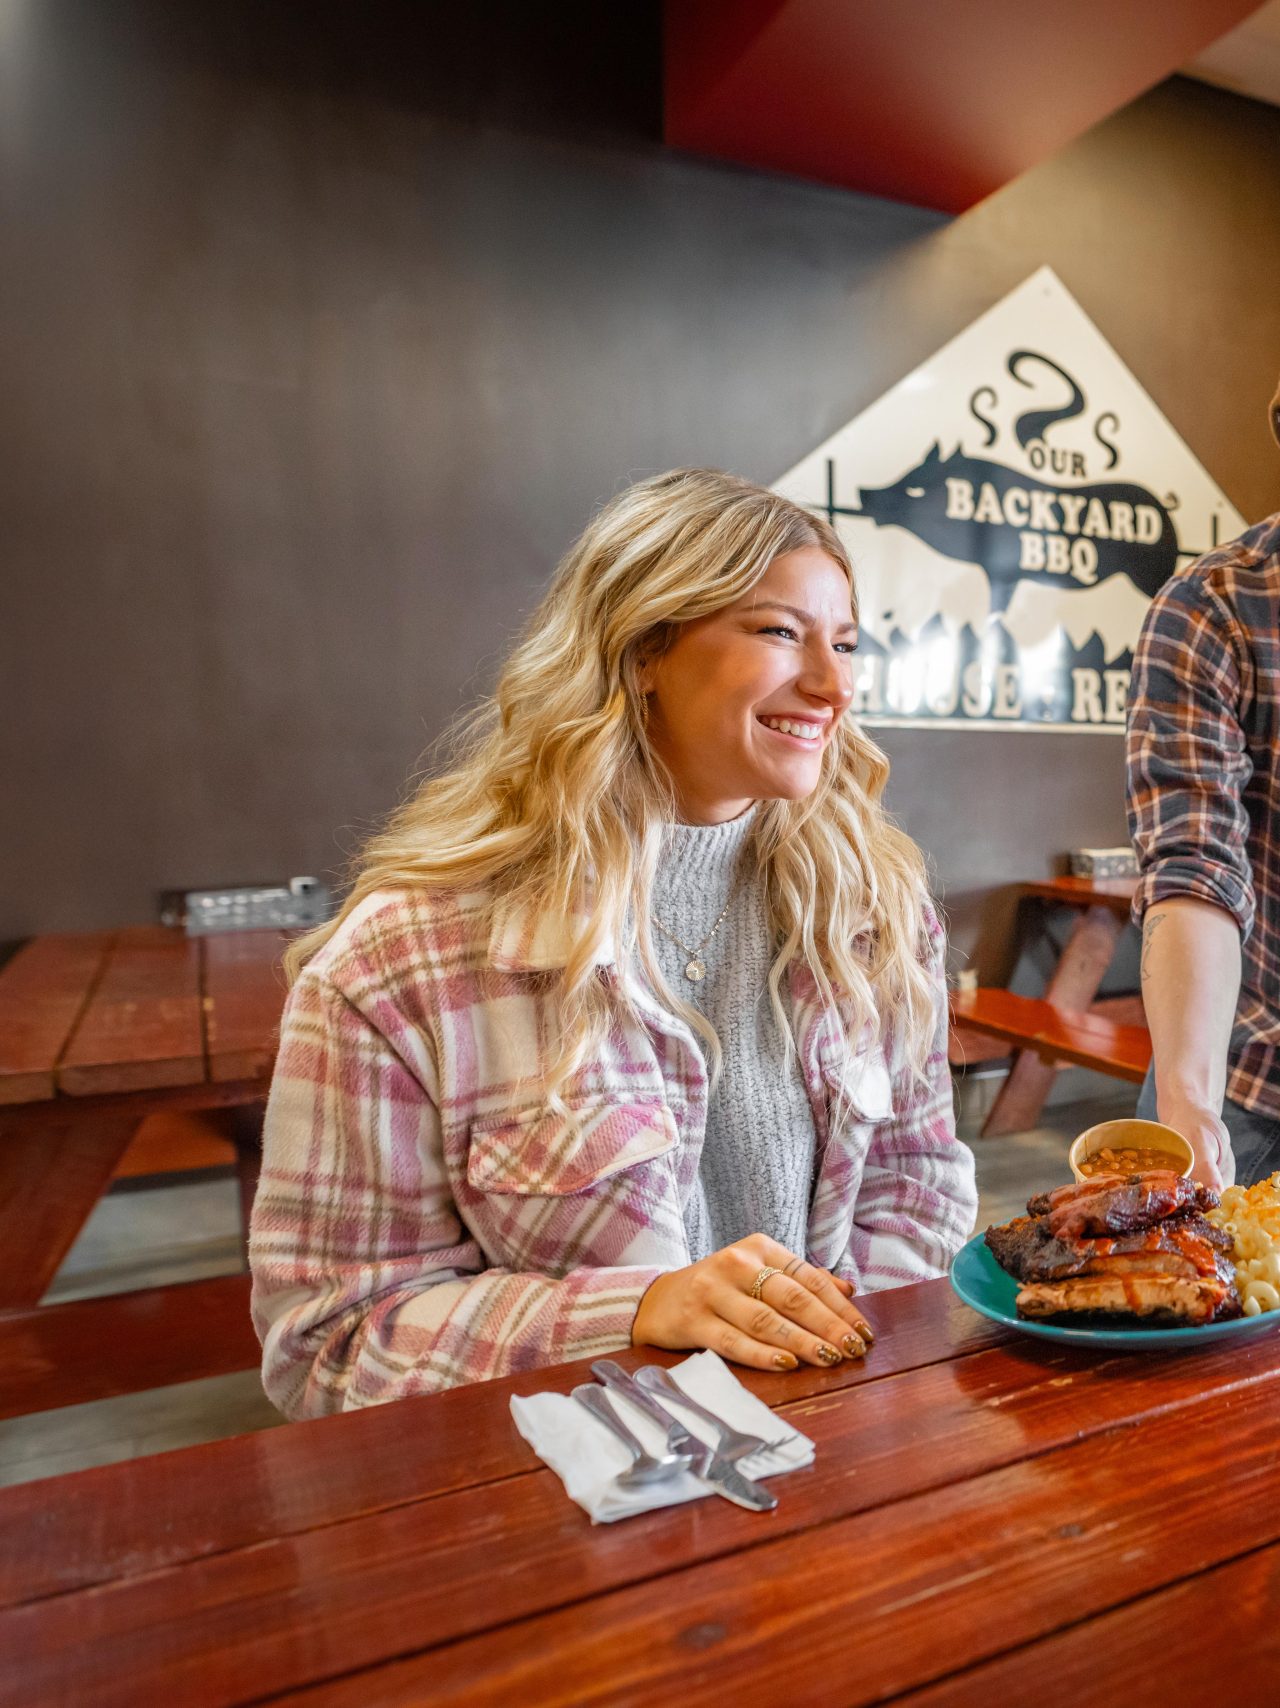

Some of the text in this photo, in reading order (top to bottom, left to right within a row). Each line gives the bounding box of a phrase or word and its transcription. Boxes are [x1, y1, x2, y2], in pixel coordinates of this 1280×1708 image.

[1029, 446, 1087, 478] OUR
[945, 477, 1163, 545] BACKYARD
[1019, 531, 1099, 585] BBQ
